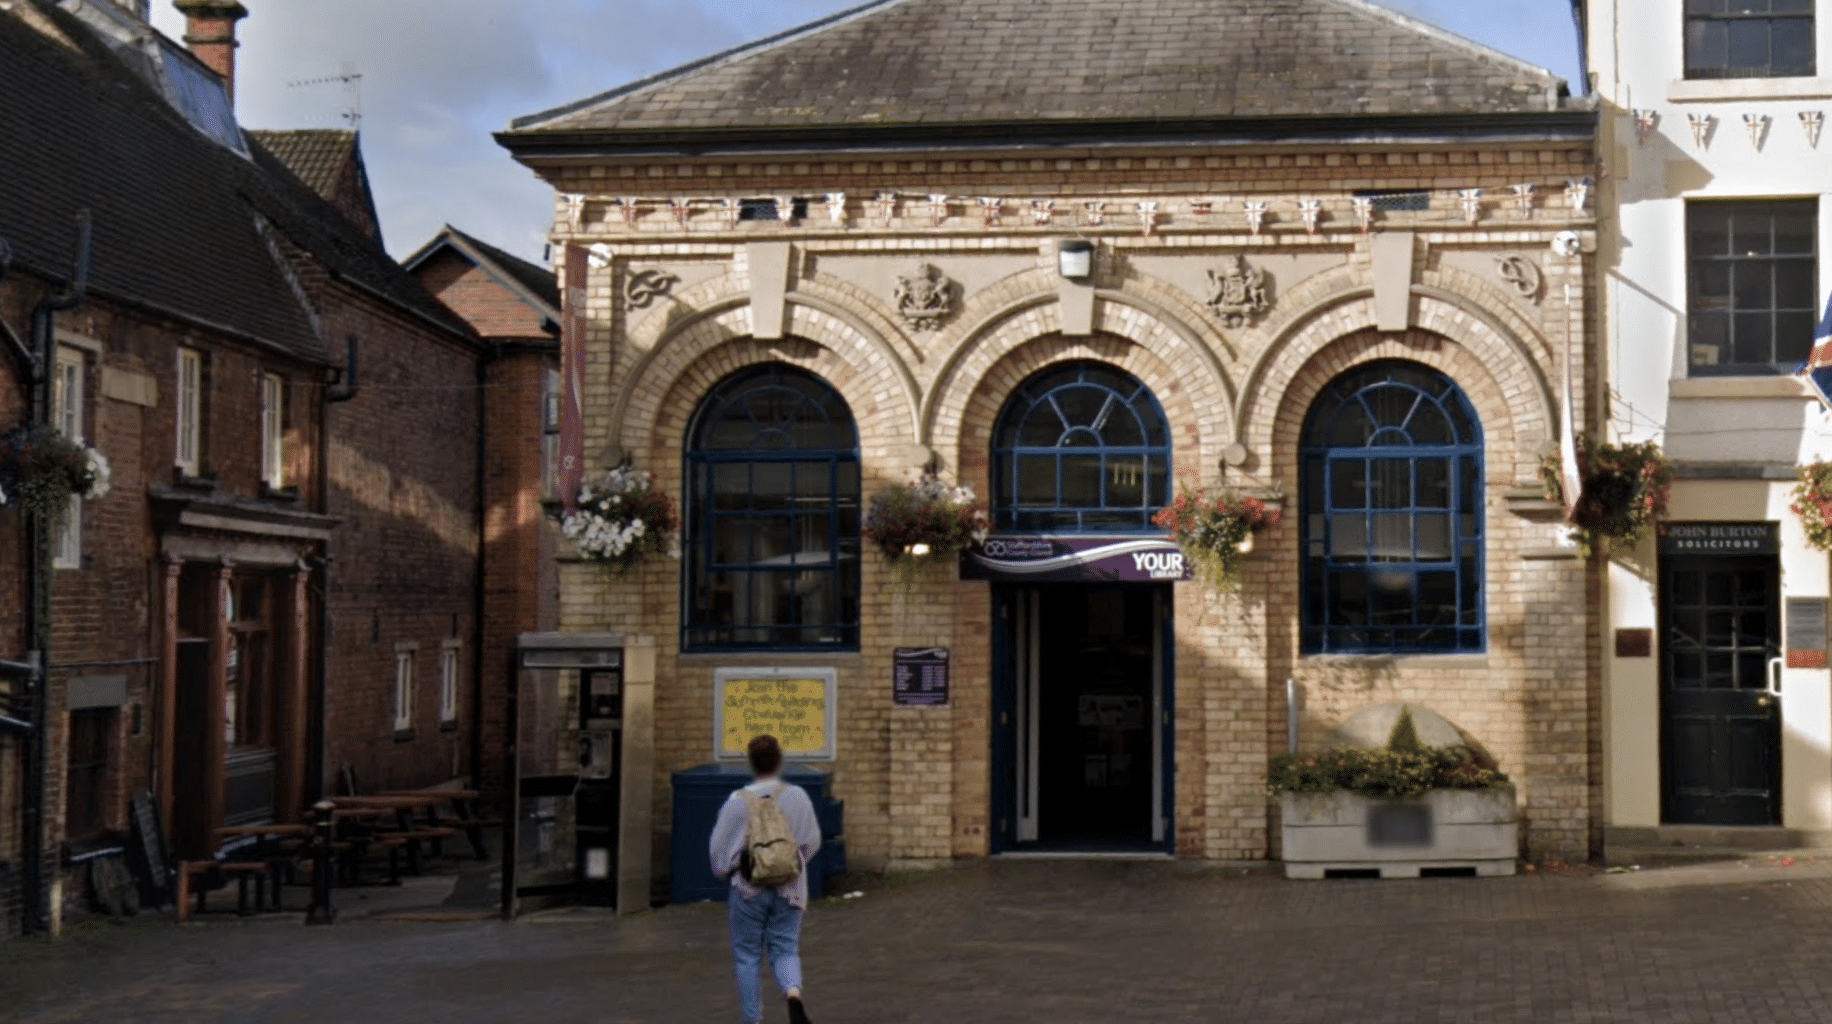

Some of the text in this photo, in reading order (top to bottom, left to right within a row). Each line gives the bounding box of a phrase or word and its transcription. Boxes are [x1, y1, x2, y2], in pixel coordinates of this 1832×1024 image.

[1668, 526, 1768, 537] JOHN BURTON
[1677, 540, 1761, 549] SOLICITORS
[1132, 553, 1183, 571] YOUR
